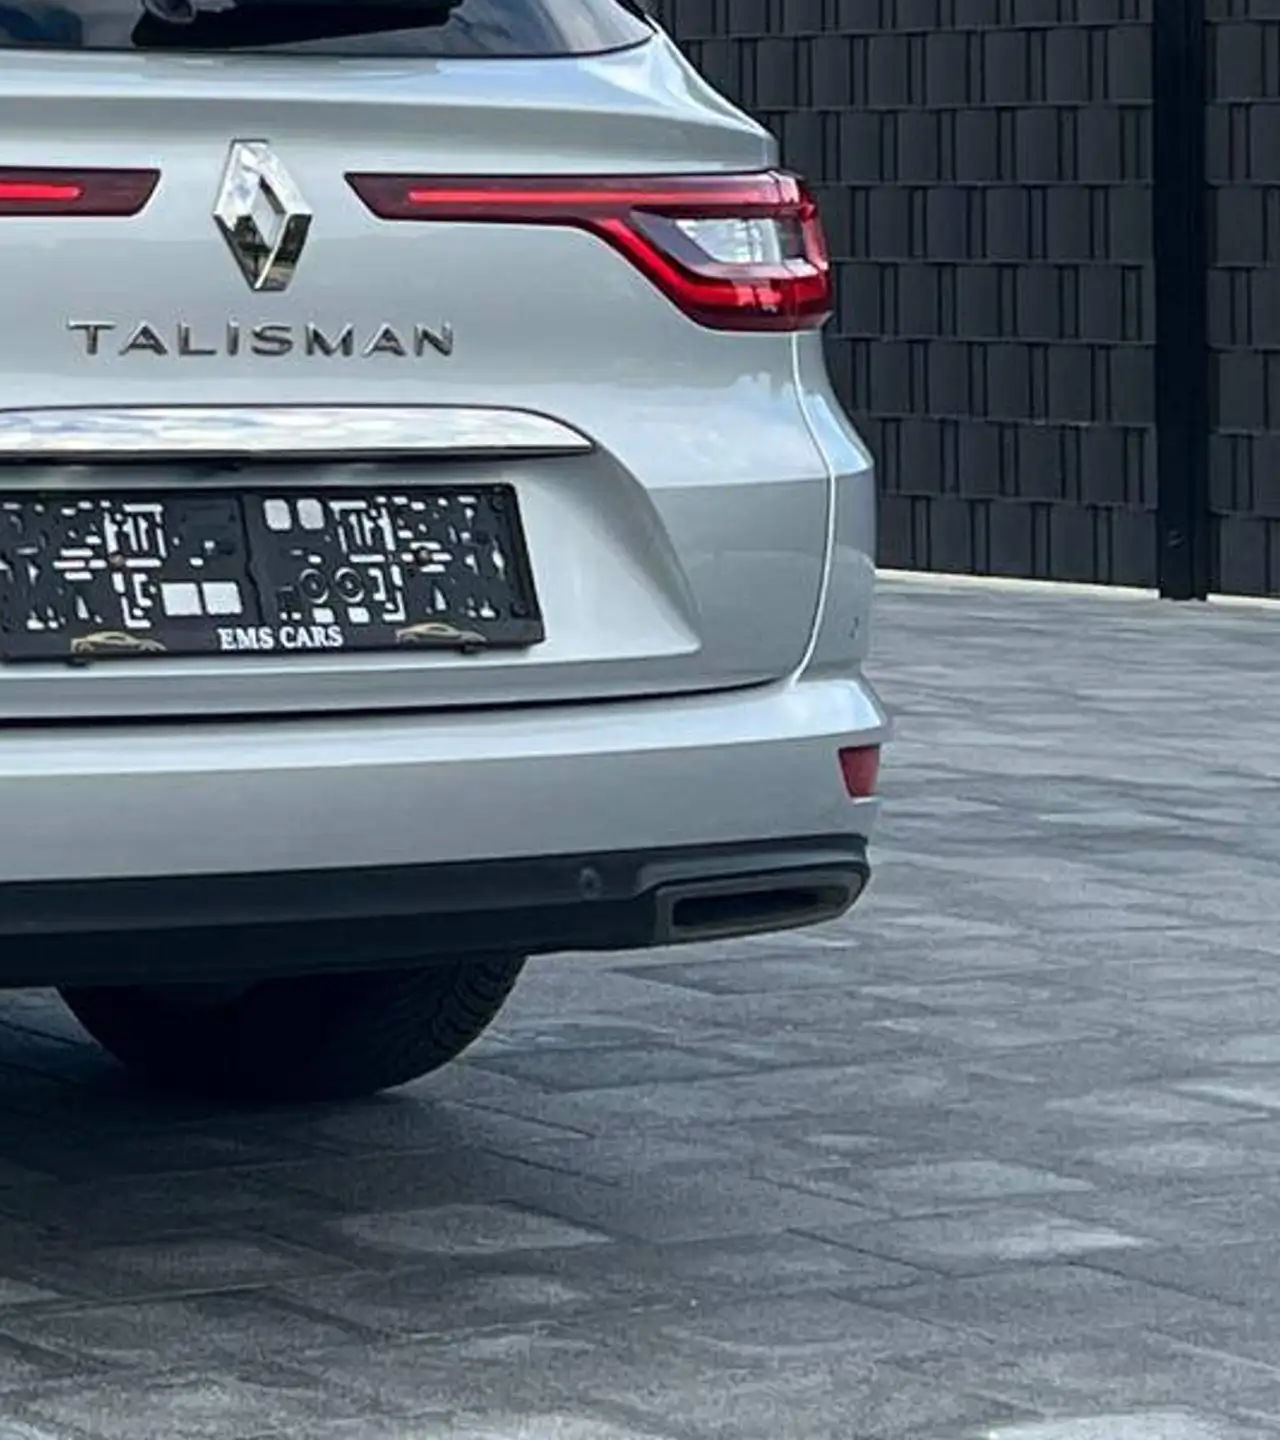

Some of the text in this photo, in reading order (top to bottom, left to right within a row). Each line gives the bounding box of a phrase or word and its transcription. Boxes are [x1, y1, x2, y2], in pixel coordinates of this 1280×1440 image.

[66, 317, 454, 357] TALISMAN
[217, 625, 343, 650] EMS CARS
